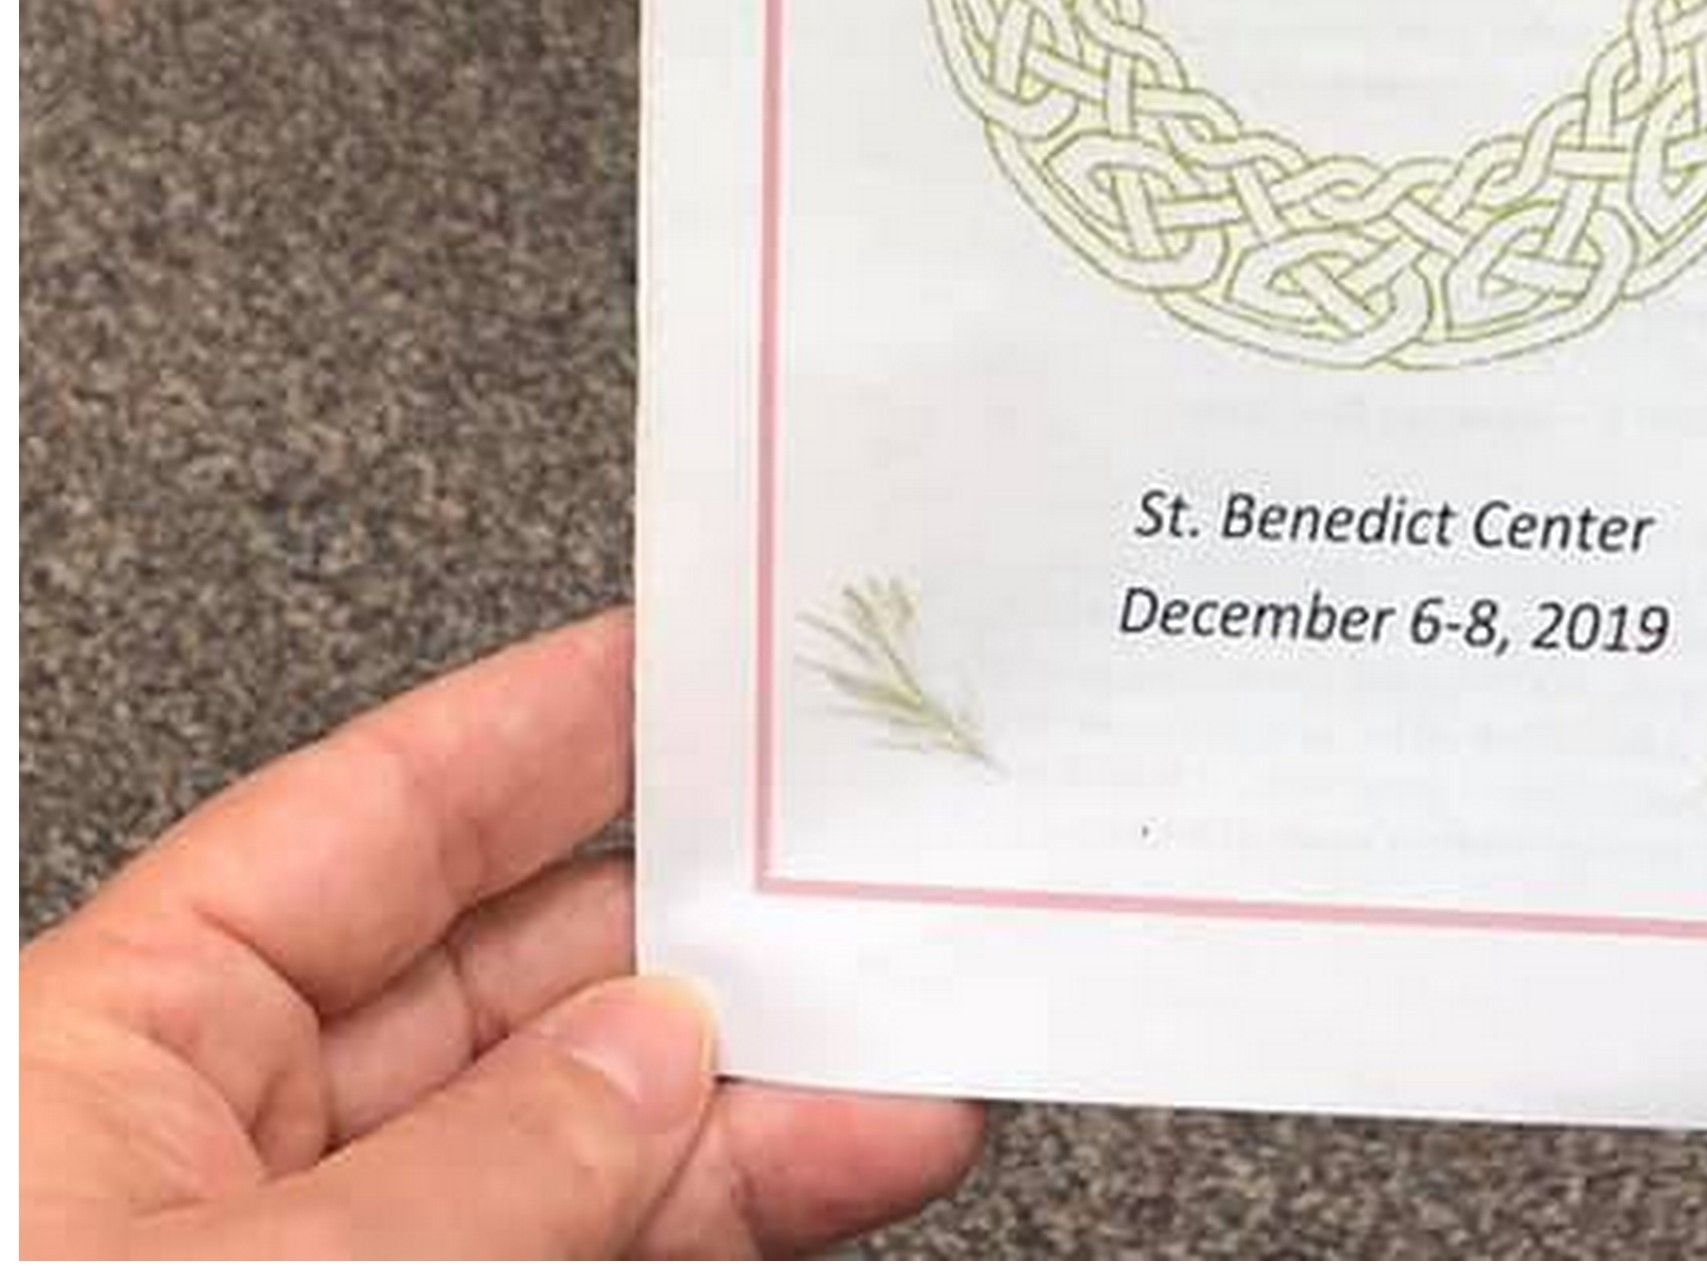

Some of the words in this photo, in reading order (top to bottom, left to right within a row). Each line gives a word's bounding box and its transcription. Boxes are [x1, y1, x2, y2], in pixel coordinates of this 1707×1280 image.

[1133, 488, 1200, 538] St.
[1221, 492, 1457, 547] Benedict
[1472, 500, 1656, 553] Center
[1119, 586, 1396, 644] December
[1410, 597, 1510, 656] 6-8,
[1530, 601, 1671, 654] 2019
